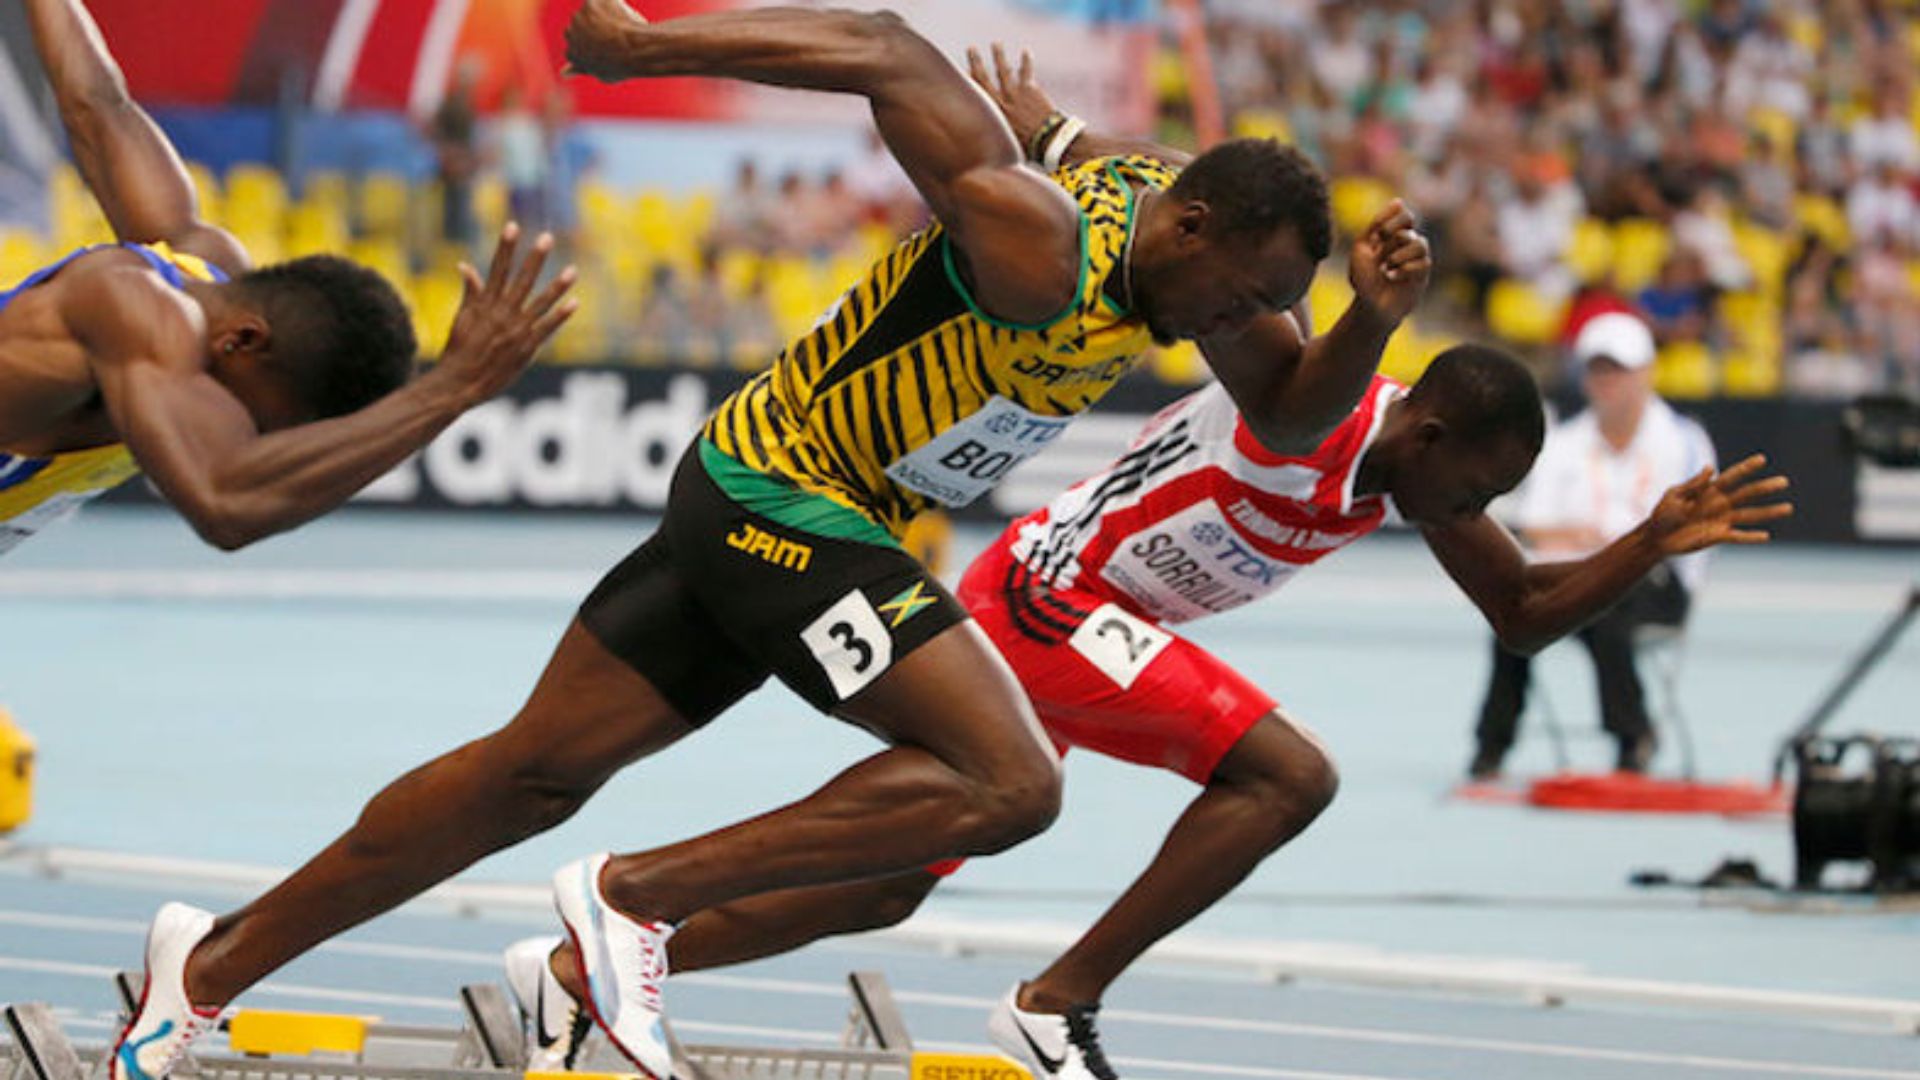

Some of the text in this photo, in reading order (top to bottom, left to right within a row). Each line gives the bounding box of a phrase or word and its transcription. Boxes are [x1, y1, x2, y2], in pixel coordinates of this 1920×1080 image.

[726, 523, 813, 572] JAM
[1215, 538, 1298, 585] TDK
[828, 621, 873, 674] 3
[1096, 619, 1152, 663] 2
[921, 1065, 1022, 1080] SEIKO
